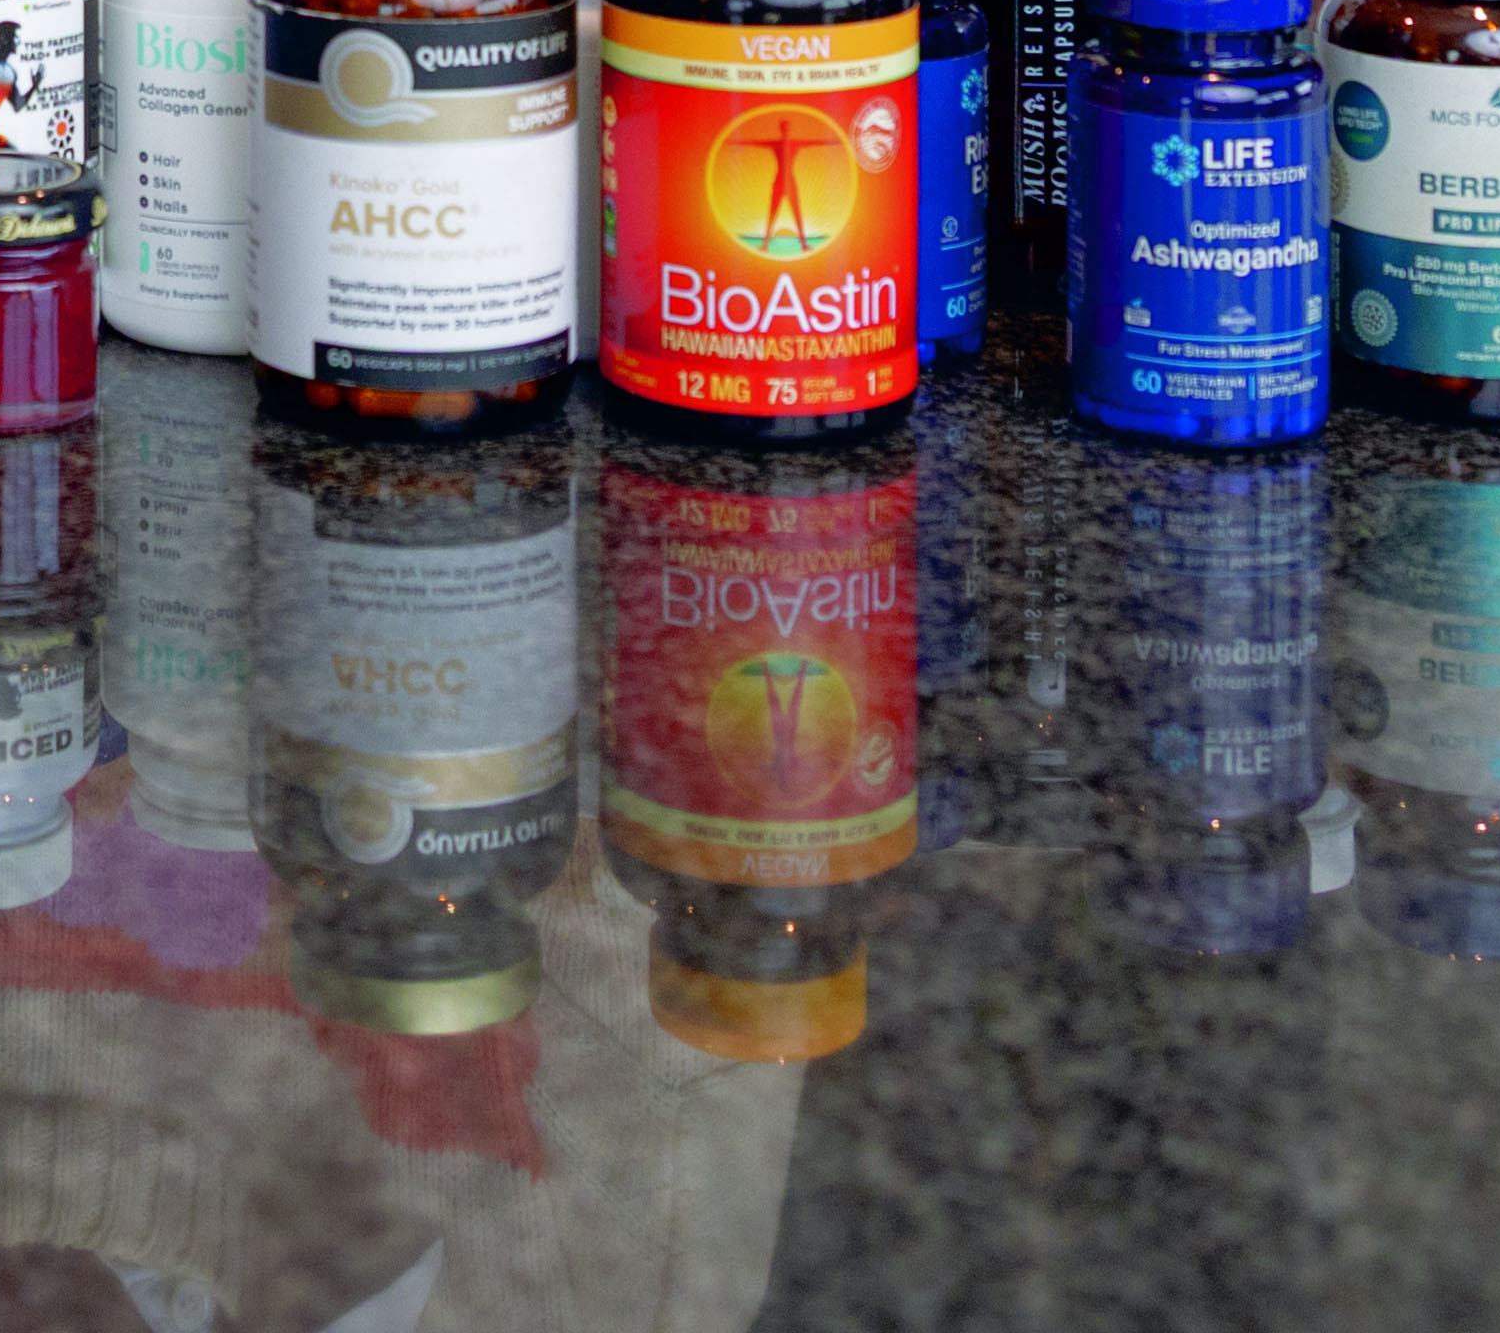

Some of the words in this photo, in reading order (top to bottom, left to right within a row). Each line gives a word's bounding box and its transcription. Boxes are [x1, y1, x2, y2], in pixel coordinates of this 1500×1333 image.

[136, 21, 246, 75] Biosi
[415, 41, 514, 72] QUALITY
[739, 35, 831, 61] VEGAN
[139, 83, 206, 100] Advanced
[516, 85, 568, 113] IMMUNE
[138, 98, 199, 118] Collagen
[1430, 109, 1471, 126] MCS
[153, 155, 181, 168] Hair
[1022, 117, 1046, 205] MUSH
[1202, 137, 1274, 170] LIFE
[153, 176, 182, 191] Skin
[411, 177, 460, 195] Gold
[1203, 165, 1308, 188] EXTENSION
[153, 199, 189, 215] Nails
[329, 200, 467, 239] AHCC
[1438, 213, 1473, 230] PRO
[139, 223, 189, 238] CLINICALLY
[190, 229, 230, 240] PROVEN
[1190, 219, 1281, 244] Optimized
[156, 247, 173, 260] 60
[1131, 235, 1319, 277] Ashwagandha
[1382, 262, 1407, 279] Pro
[1409, 268, 1481, 288] Liposomal
[1444, 259, 1466, 275] mg
[140, 284, 170, 300] Dietary
[172, 289, 230, 302] Supplement
[328, 276, 408, 298] Significantly
[412, 284, 473, 298] improves
[477, 278, 522, 293] immune
[660, 262, 897, 333] BioAstin
[328, 295, 391, 311] Maintains
[395, 301, 428, 314] peak
[432, 301, 476, 312] natural
[480, 296, 510, 310] killer
[946, 295, 967, 319] 60
[1454, 301, 1500, 313] Without
[328, 313, 396, 330] Supported
[400, 317, 416, 332] by
[420, 321, 450, 330] over
[475, 315, 515, 328] human
[660, 324, 764, 360] HAWAIIAN
[764, 324, 897, 362] ASTAXANTHIN
[1157, 339, 1182, 357] For
[1183, 341, 1228, 360] Stress
[1228, 339, 1304, 360] Management
[326, 347, 352, 369] 60
[677, 369, 705, 399] 12
[710, 374, 751, 403] MG
[766, 376, 798, 406] 75
[865, 370, 876, 396] 1
[1131, 368, 1162, 394] 60
[1165, 371, 1247, 390] VEGETARIAN
[1165, 386, 1234, 400] CAPSULES
